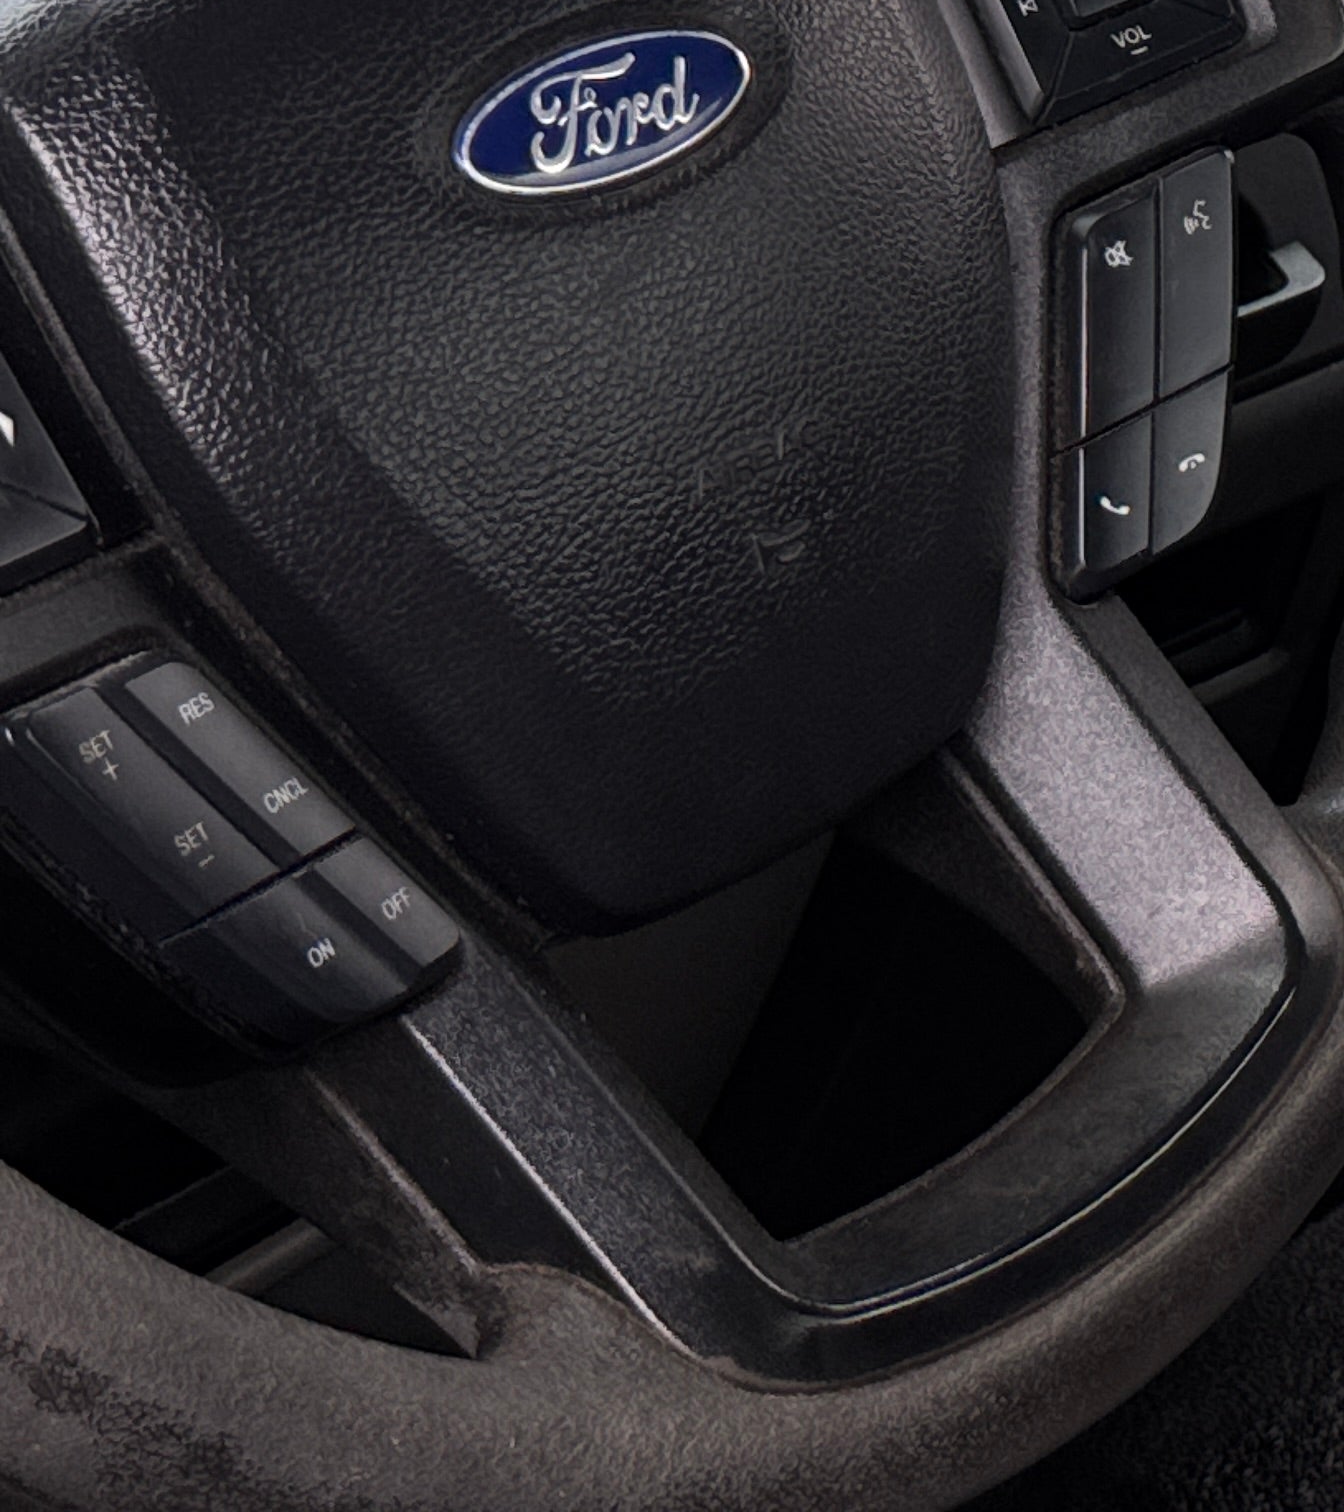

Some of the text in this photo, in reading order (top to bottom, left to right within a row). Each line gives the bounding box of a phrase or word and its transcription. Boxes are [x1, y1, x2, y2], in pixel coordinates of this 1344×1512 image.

[1110, 25, 1152, 49] VOL
[530, 52, 700, 174] Ford
[178, 692, 215, 727] RES
[79, 730, 114, 764] SET
[263, 777, 310, 814] CNCL
[174, 821, 209, 856] SET
[381, 887, 412, 920] OFF
[307, 938, 337, 968] ON
